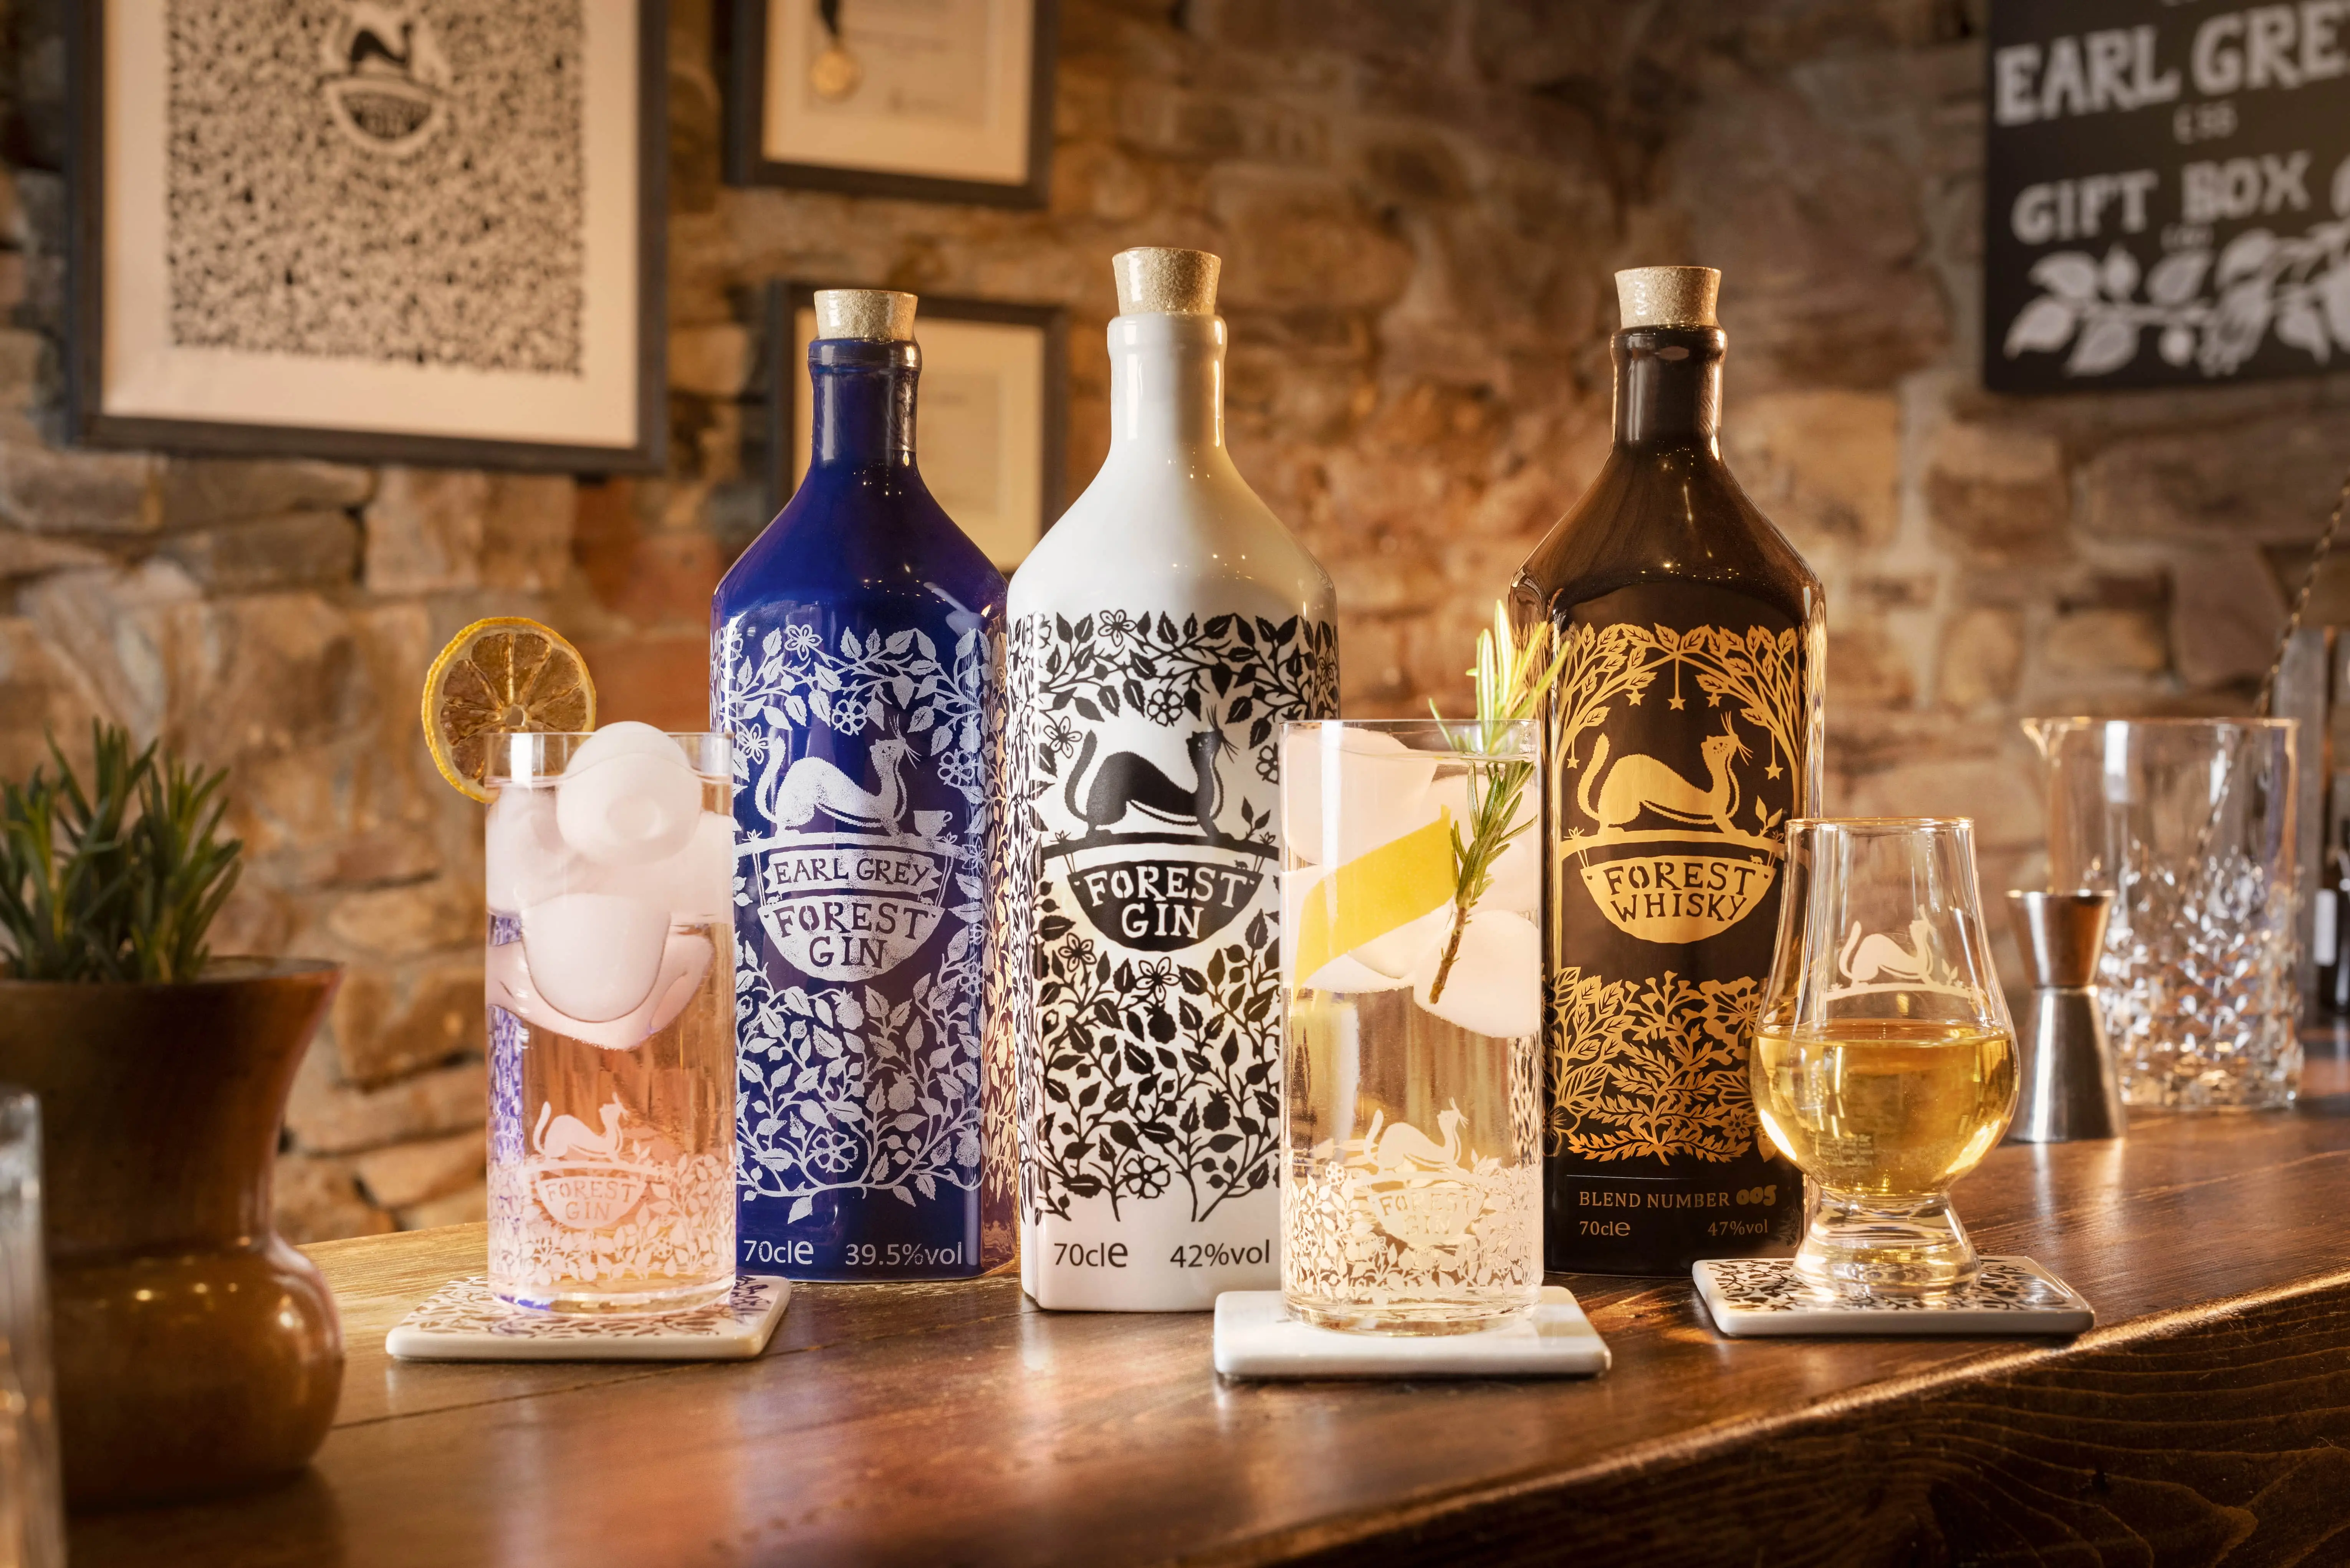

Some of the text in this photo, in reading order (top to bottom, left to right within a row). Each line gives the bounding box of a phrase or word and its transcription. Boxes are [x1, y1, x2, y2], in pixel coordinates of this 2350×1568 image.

[1994, 25, 2181, 126] EARL
[2011, 169, 2158, 245] GIFT
[2182, 150, 2311, 222] BOX
[775, 858, 930, 886] EARL GREY
[1084, 865, 1249, 908] FOREST
[1603, 862, 1756, 895] FOREST
[772, 901, 929, 939] FOREST
[1122, 903, 1204, 939] GIN
[1610, 893, 1748, 922] WHISKY
[809, 936, 887, 969] GIN
[546, 1180, 638, 1202] FOREST
[1379, 1192, 1478, 1216] FOREST
[1579, 1185, 1777, 1208] BLEND NUMBER 005
[565, 1201, 610, 1222] GIN
